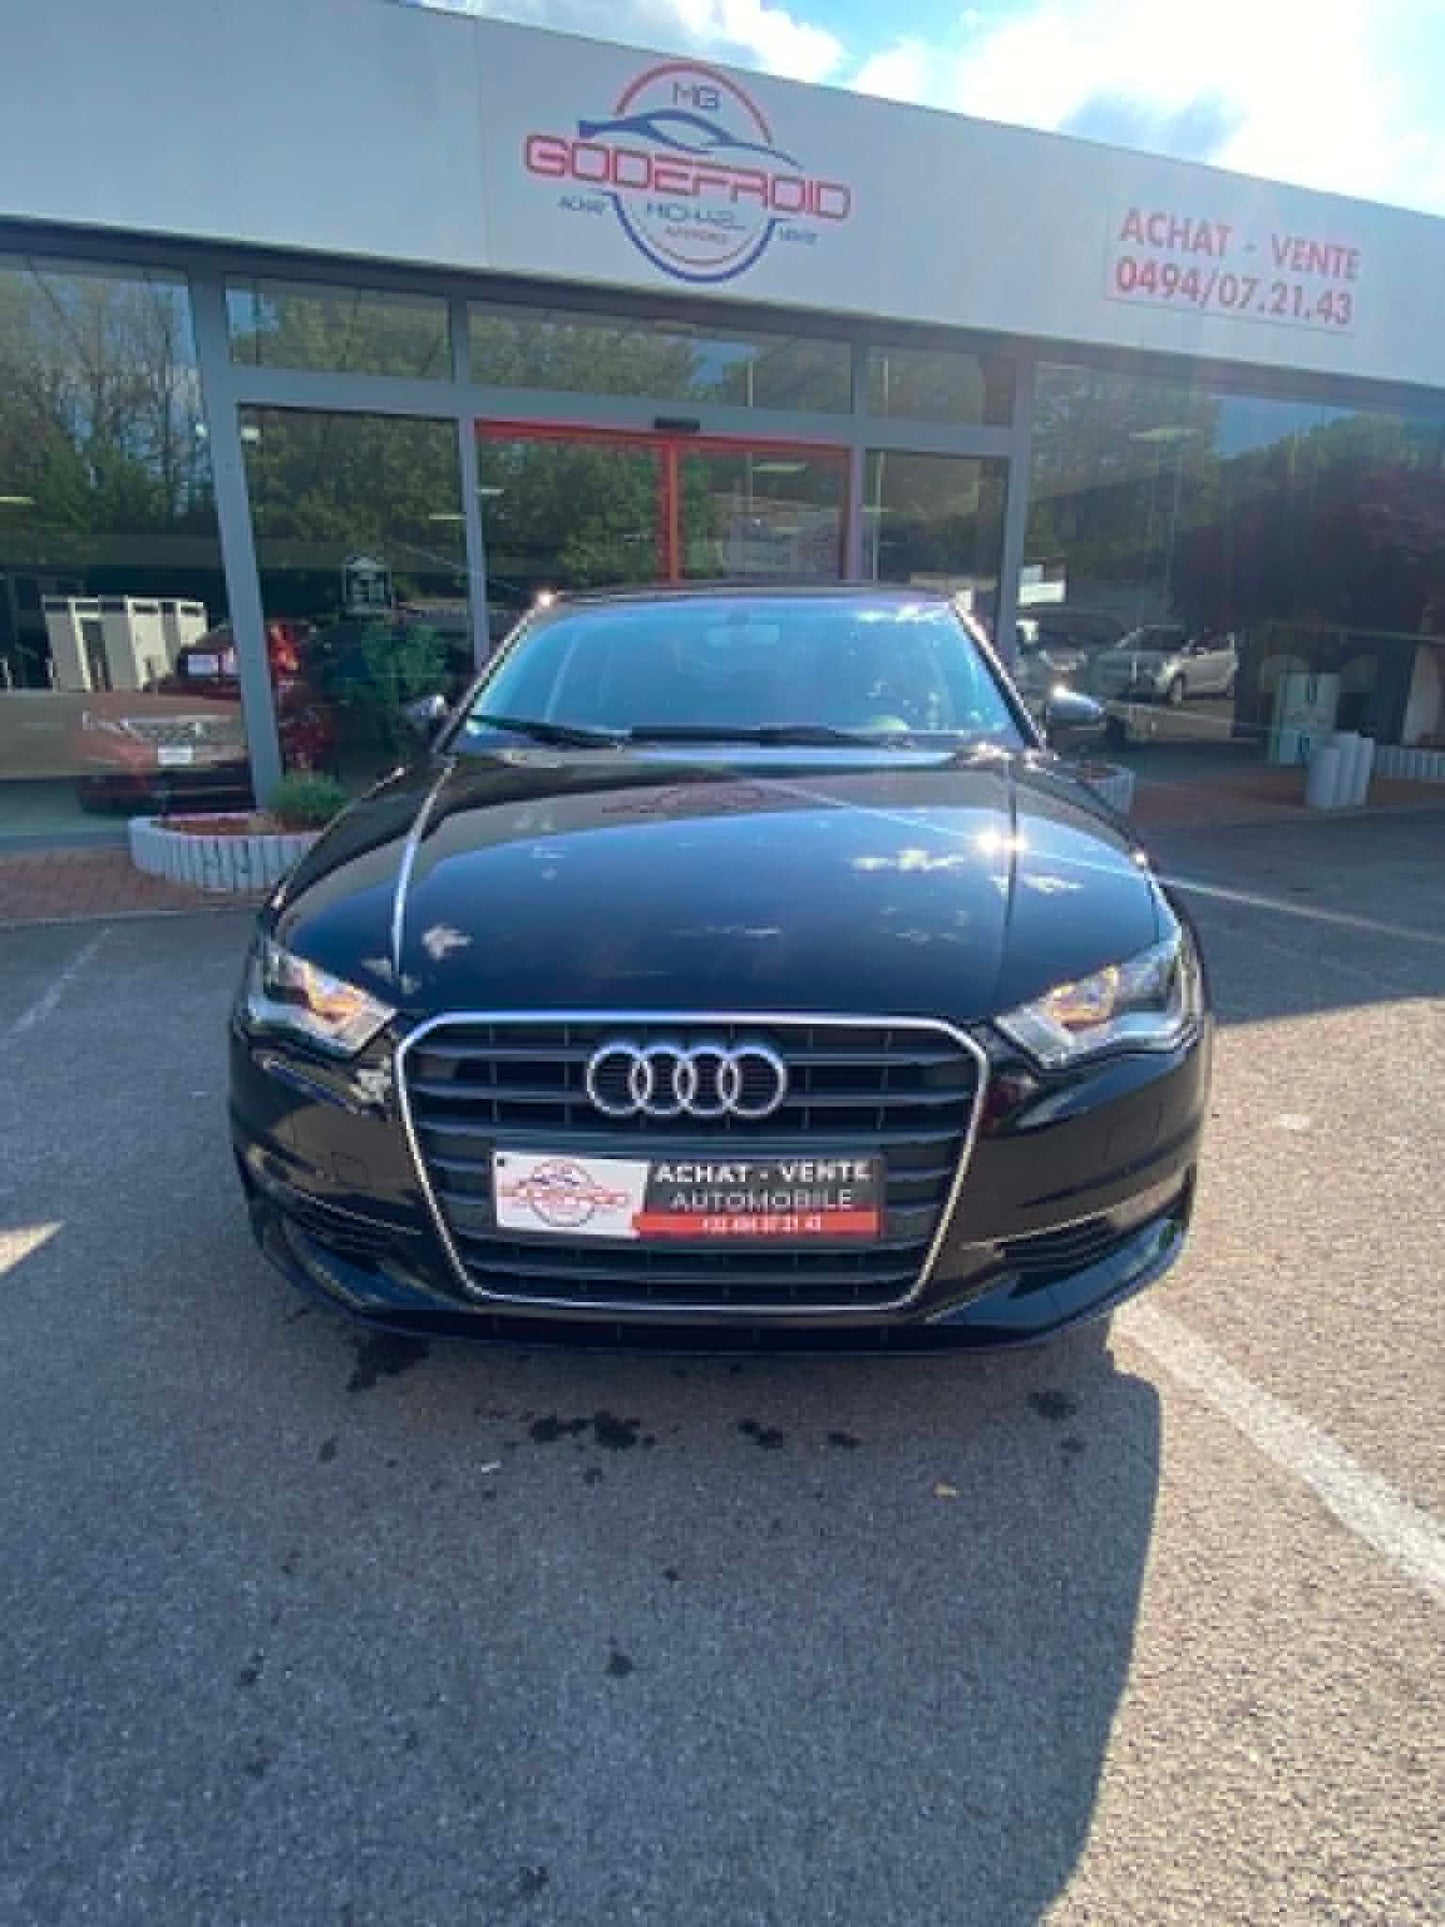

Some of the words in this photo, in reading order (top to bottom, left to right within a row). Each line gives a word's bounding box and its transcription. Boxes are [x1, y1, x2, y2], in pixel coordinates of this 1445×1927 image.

[526, 134, 850, 220] GODEFROID
[1119, 207, 1232, 256] ACHAT
[1271, 233, 1360, 279] VENTE
[1116, 255, 1353, 325] 0494/07.21.43
[655, 1164, 752, 1183] ACHAT
[781, 1162, 871, 1182] VENTE
[671, 1189, 854, 1210] AUTOMOBILE
